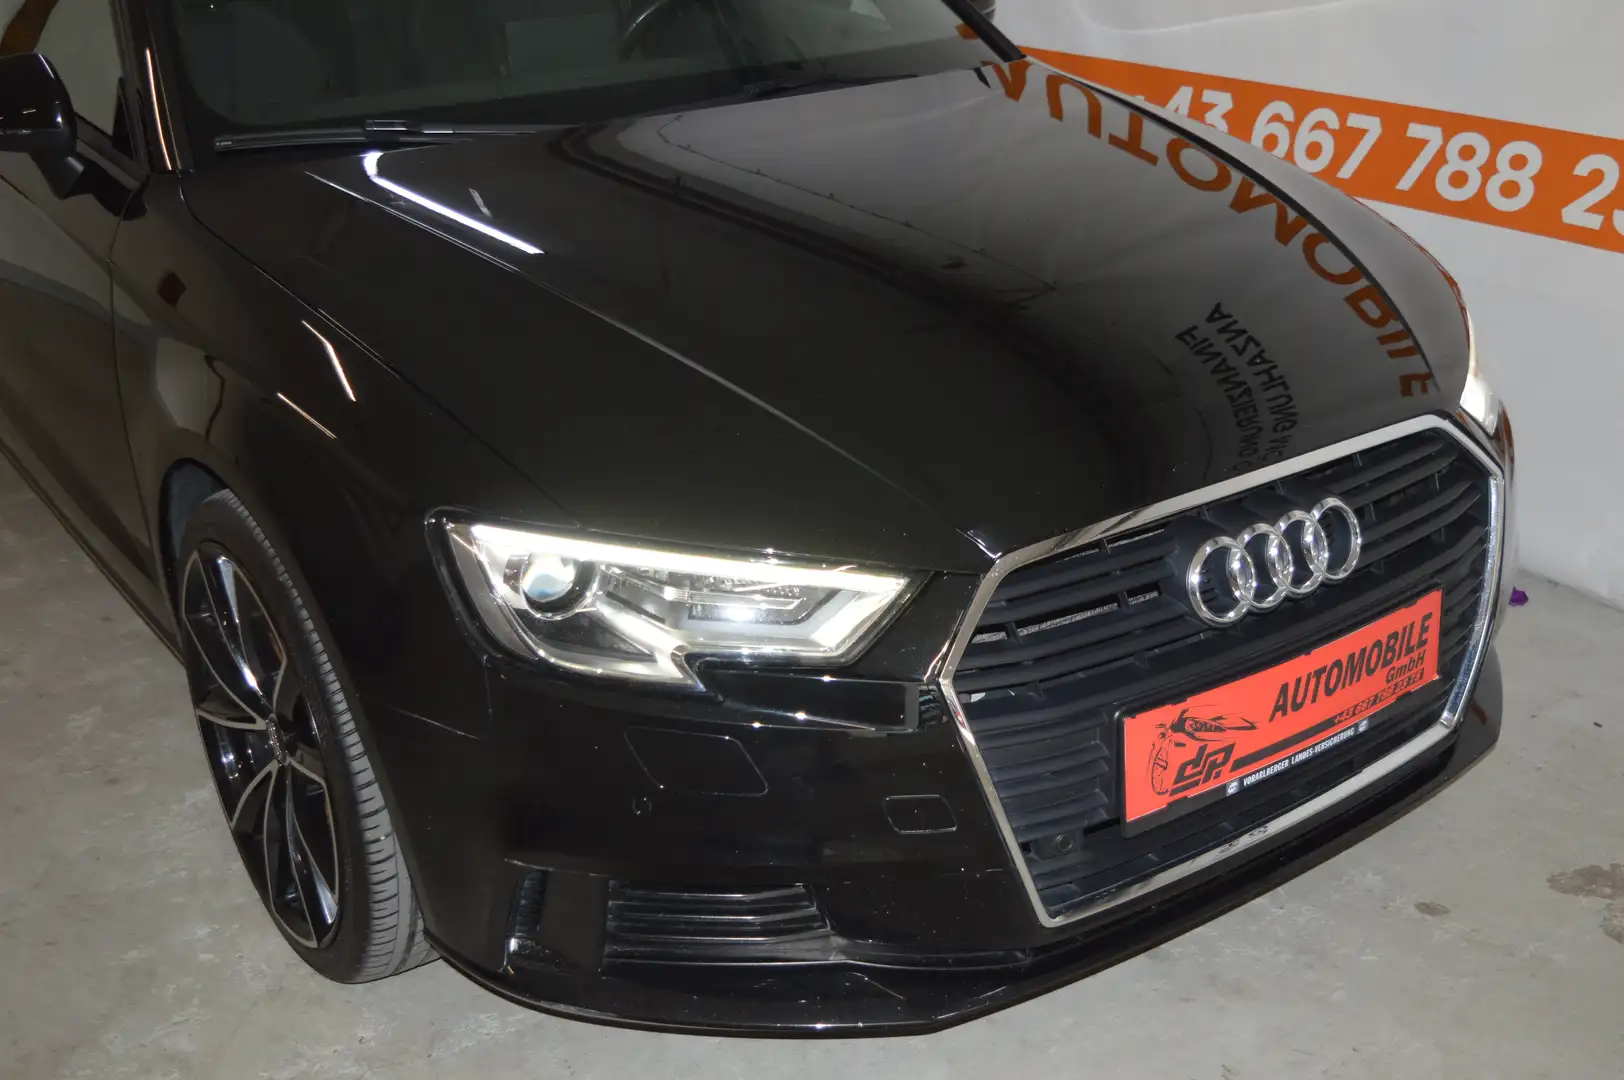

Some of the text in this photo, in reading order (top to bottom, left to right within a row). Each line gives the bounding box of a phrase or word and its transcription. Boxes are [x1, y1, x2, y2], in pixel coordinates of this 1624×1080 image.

[1251, 100, 1382, 180] 667
[1395, 122, 1543, 212] 788
[1561, 154, 1624, 240] 2
[1269, 612, 1432, 722] AUTOMOBILE
[1385, 649, 1426, 685] GmbH
[1243, 726, 1356, 787] VORARLBERGER LANDES-VERSICHERUNG
